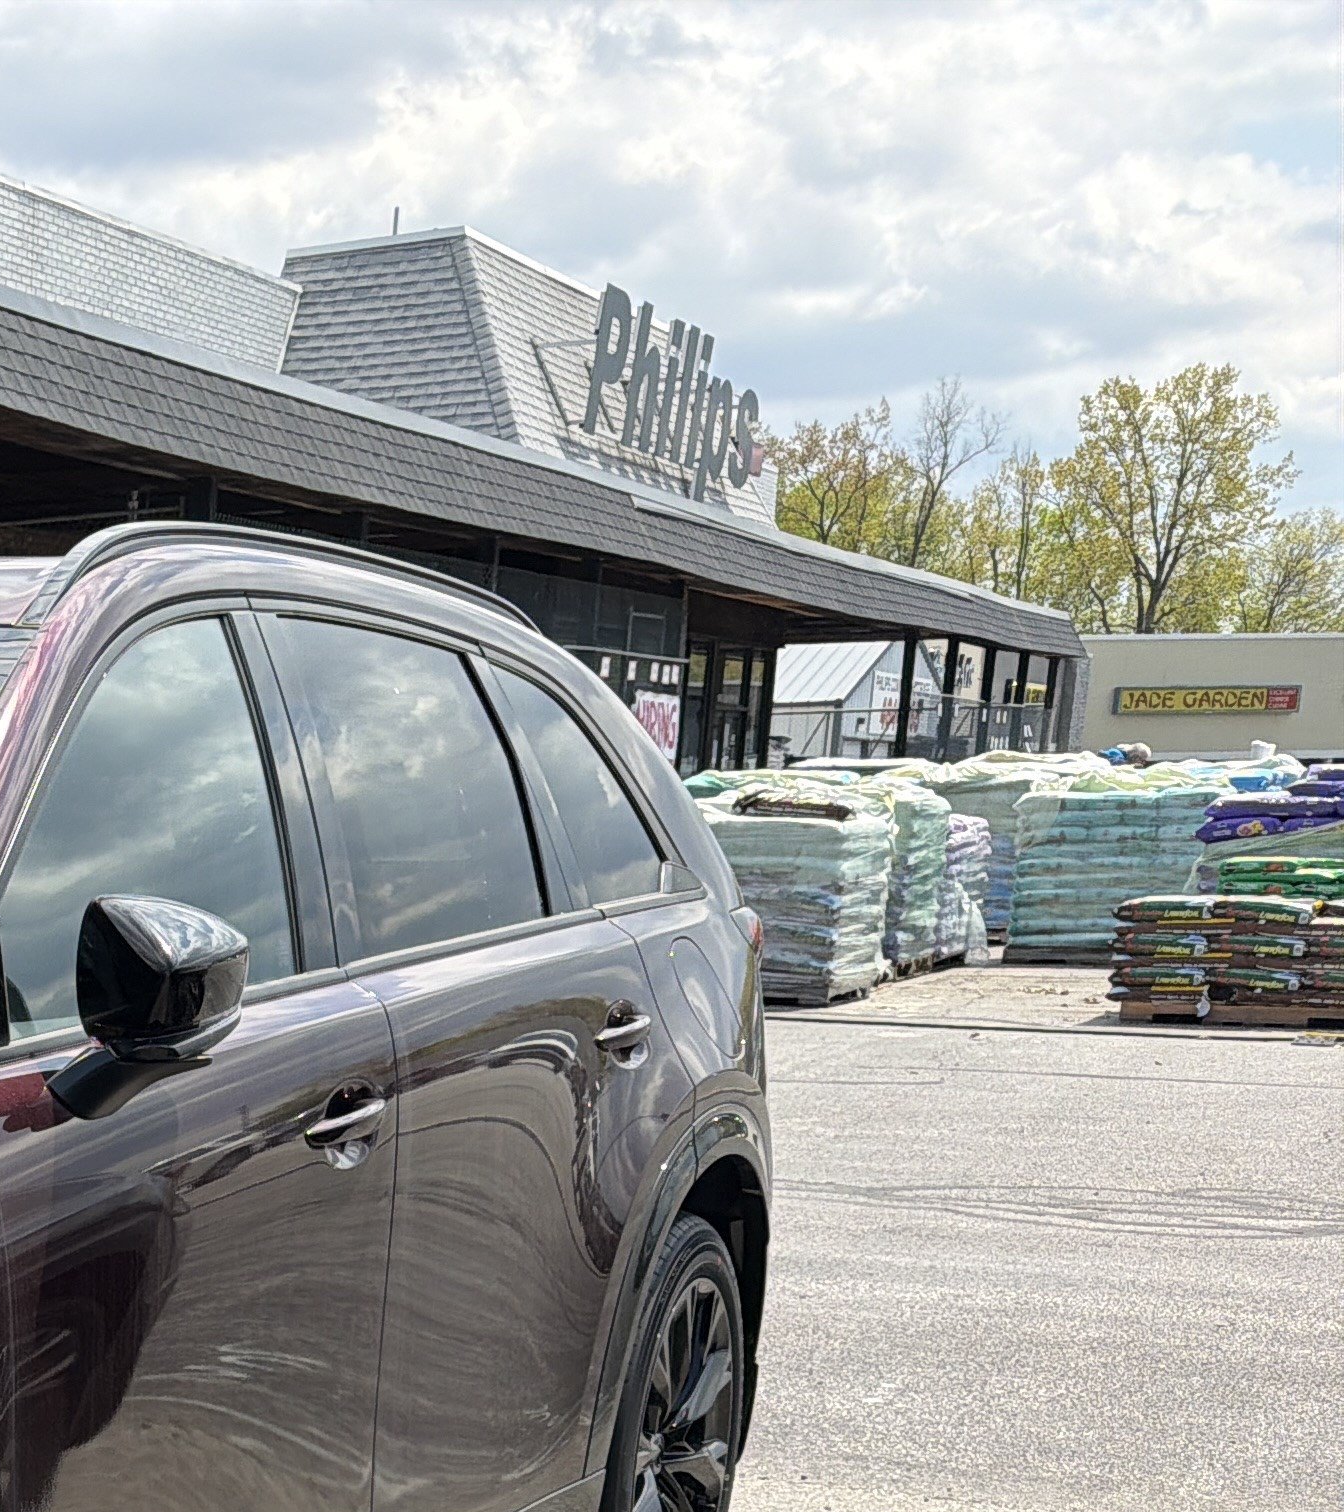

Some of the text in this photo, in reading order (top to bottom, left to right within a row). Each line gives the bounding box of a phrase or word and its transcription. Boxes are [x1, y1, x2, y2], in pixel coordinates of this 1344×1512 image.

[582, 282, 759, 503] Philips
[1123, 691, 1176, 710] JADE
[1182, 690, 1265, 709] GARDEN
